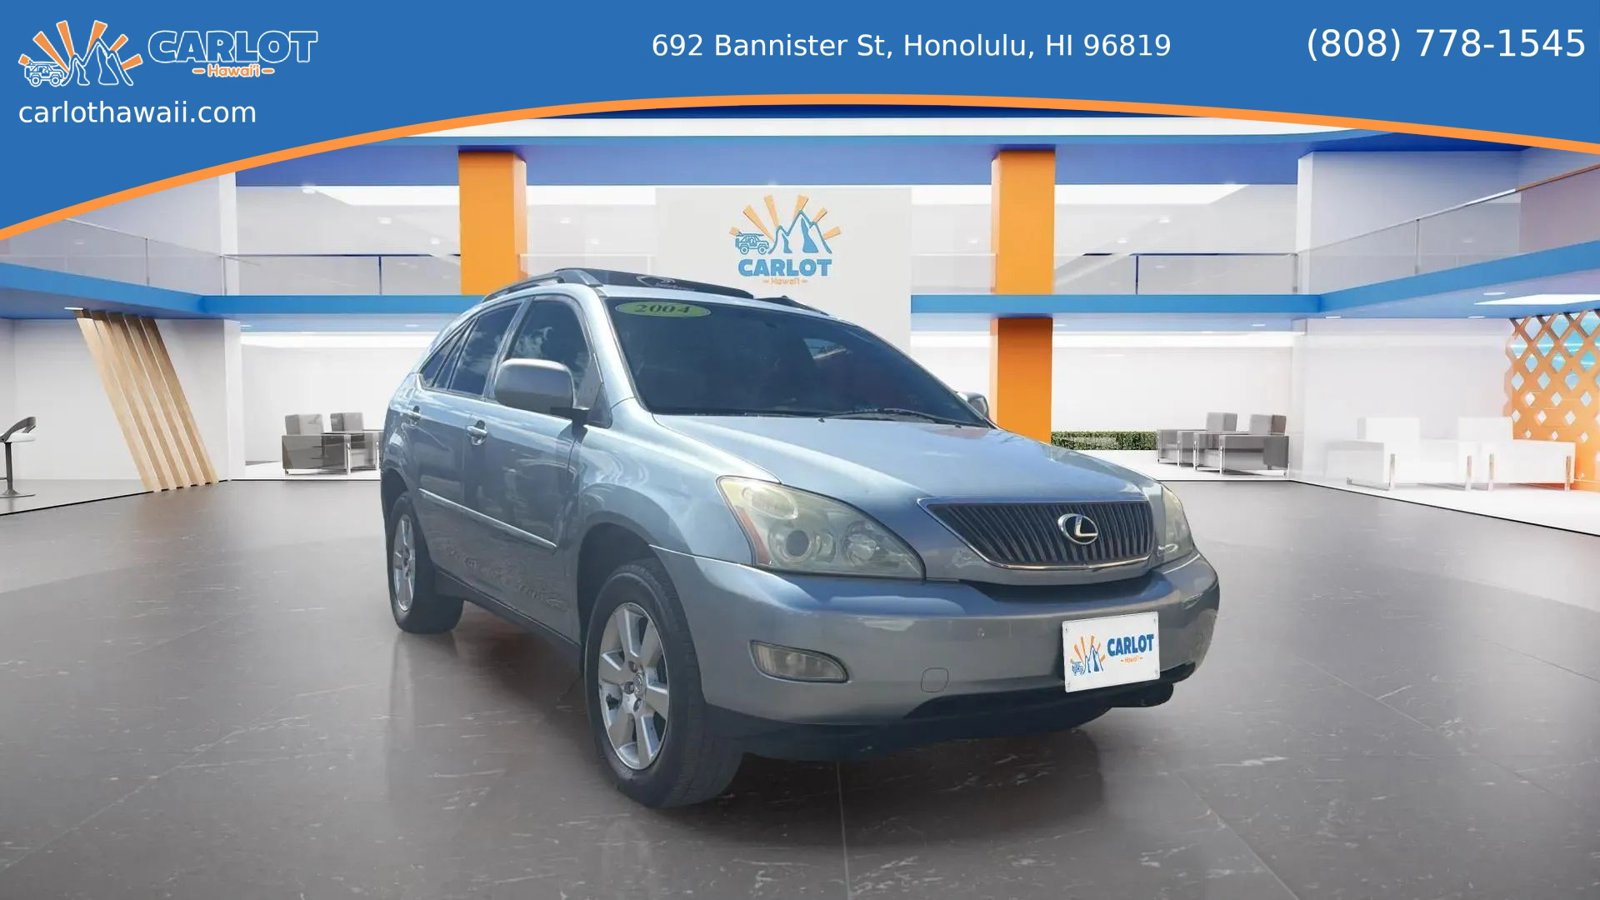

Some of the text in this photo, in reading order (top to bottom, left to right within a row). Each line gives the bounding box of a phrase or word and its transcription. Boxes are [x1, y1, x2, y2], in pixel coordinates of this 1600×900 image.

[738, 258, 832, 277] CARLOT
[635, 304, 690, 313] 2004
[1107, 633, 1154, 657] CARLOT
